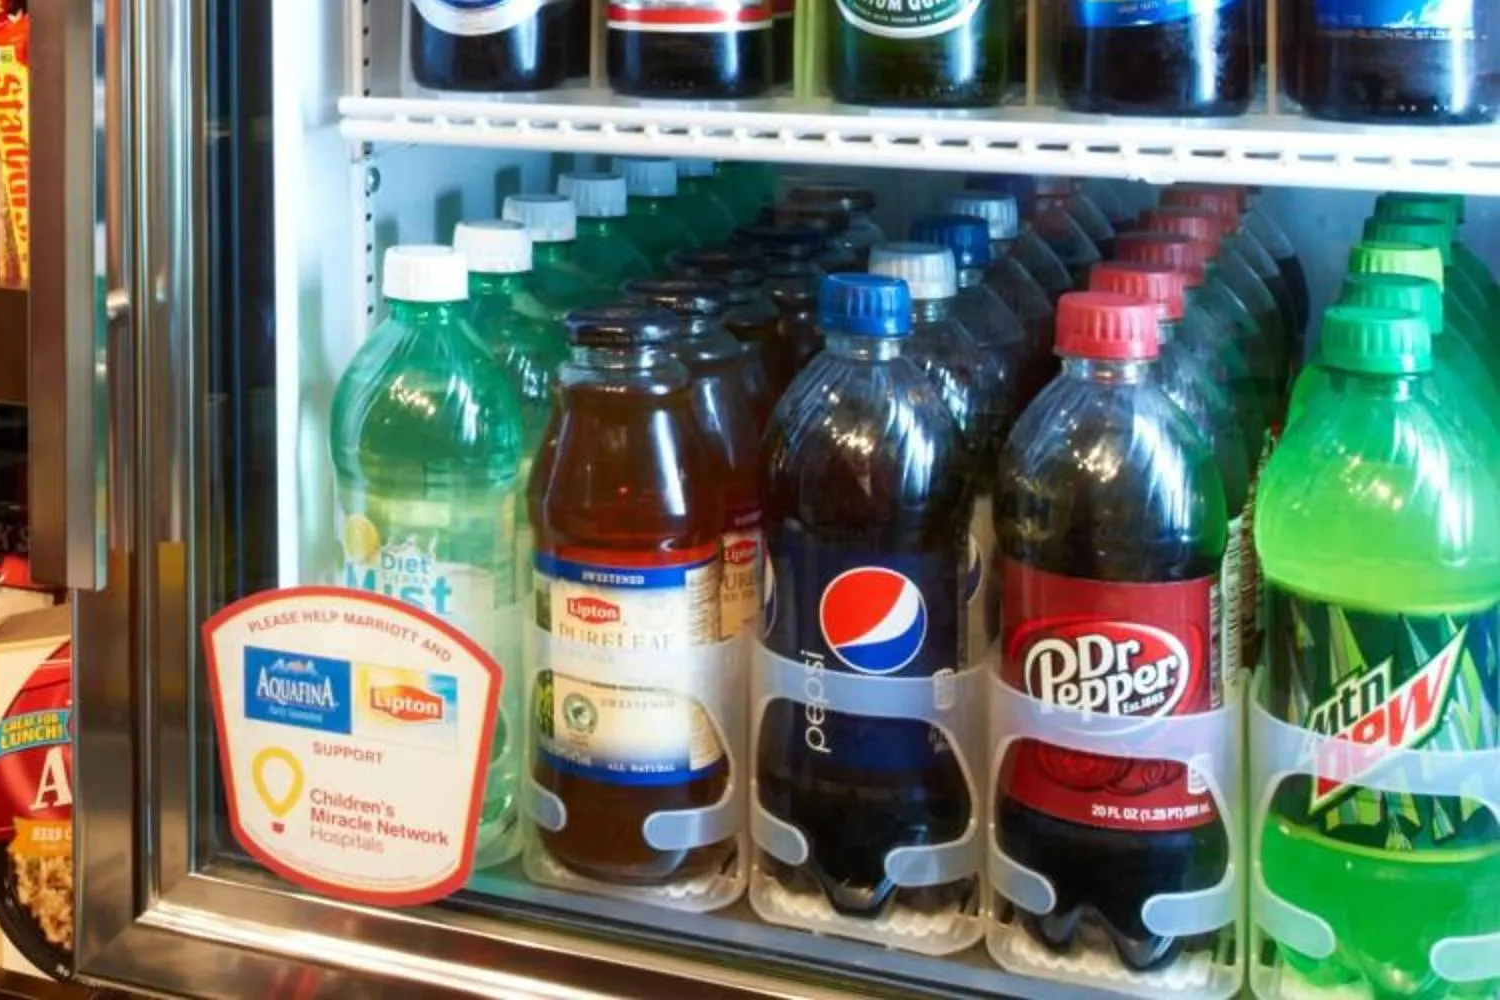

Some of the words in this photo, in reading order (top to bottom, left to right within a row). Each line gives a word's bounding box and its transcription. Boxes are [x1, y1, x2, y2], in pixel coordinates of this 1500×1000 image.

[381, 551, 432, 574] Diet
[569, 600, 619, 619] Lipton
[247, 610, 298, 634] PLEASE
[302, 611, 339, 624] HELP
[343, 612, 419, 645] MARRIOTT
[421, 638, 453, 663] AND
[1076, 633, 1142, 680] Dr
[256, 667, 336, 709] AQUAFINA
[1025, 637, 1179, 724] Pepper
[371, 687, 441, 718] Lipton
[803, 650, 832, 755] pepsi
[312, 742, 384, 766] SUPPORT
[309, 788, 396, 818] Children's
[309, 806, 373, 834] Miracle
[377, 820, 449, 847] Network
[309, 828, 385, 854] Hospitals
